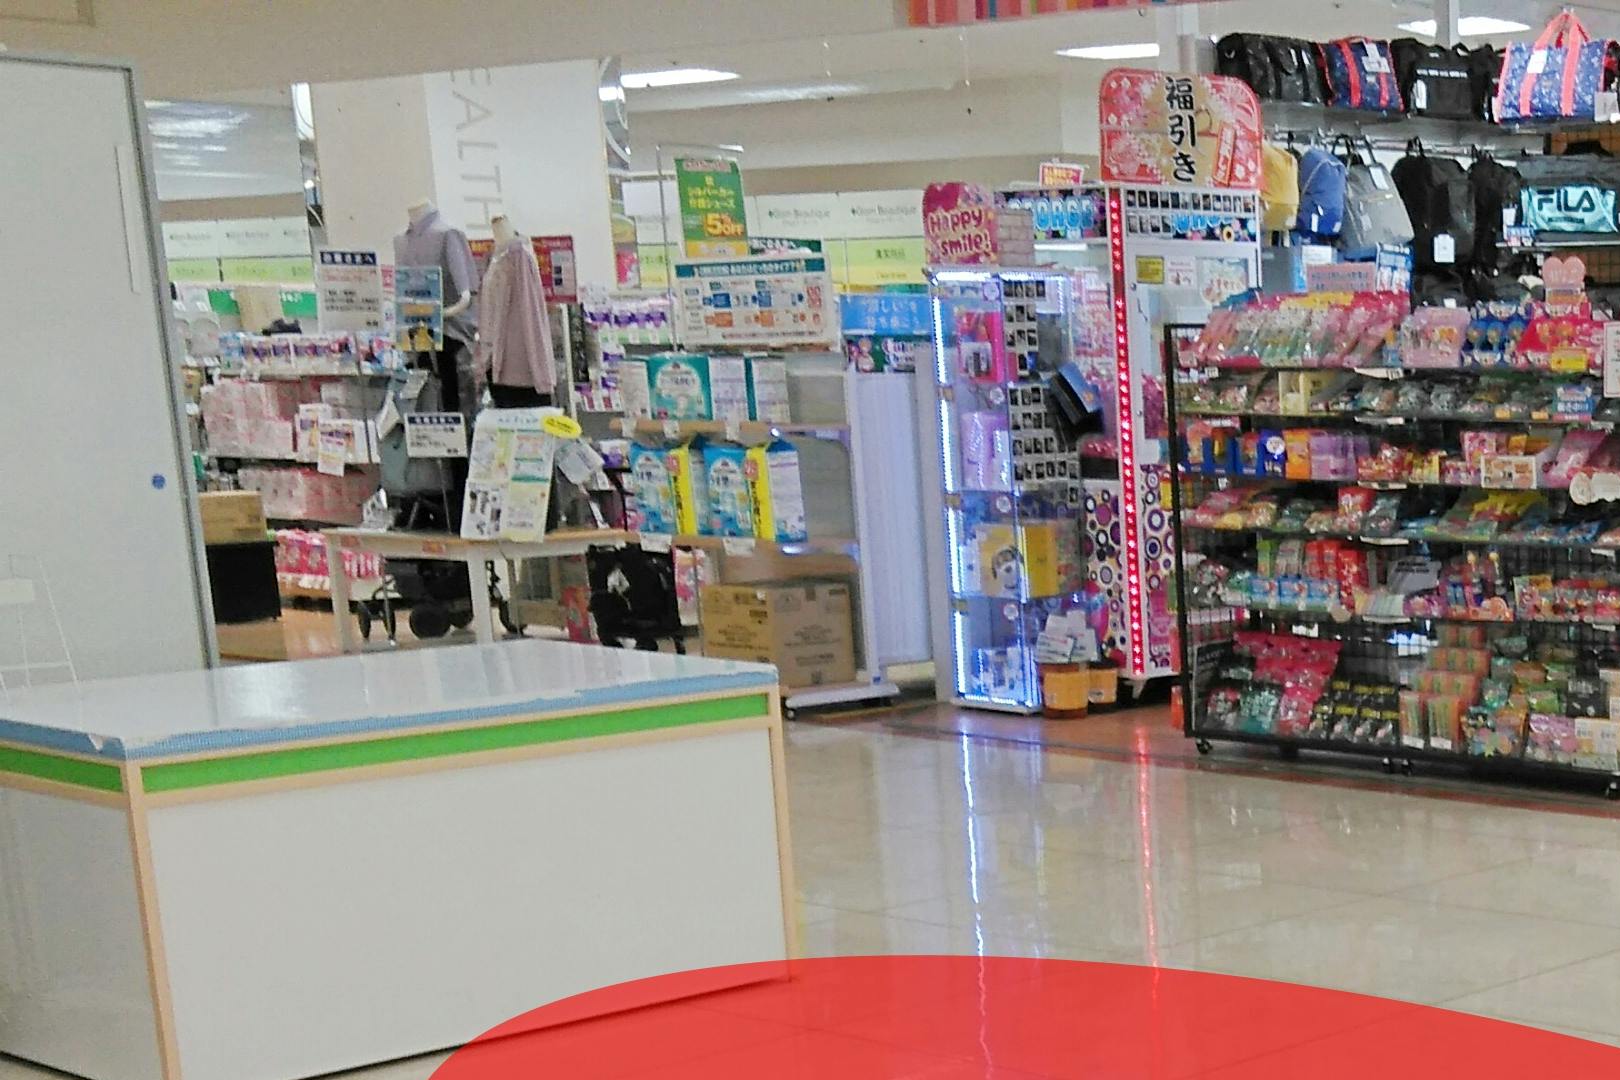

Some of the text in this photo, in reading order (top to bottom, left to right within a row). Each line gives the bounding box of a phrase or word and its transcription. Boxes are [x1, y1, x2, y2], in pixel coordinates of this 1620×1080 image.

[1165, 75, 1197, 183] 福引き
[1536, 188, 1596, 213] FILA
[928, 207, 984, 236] Happy
[940, 230, 992, 257] smile!
